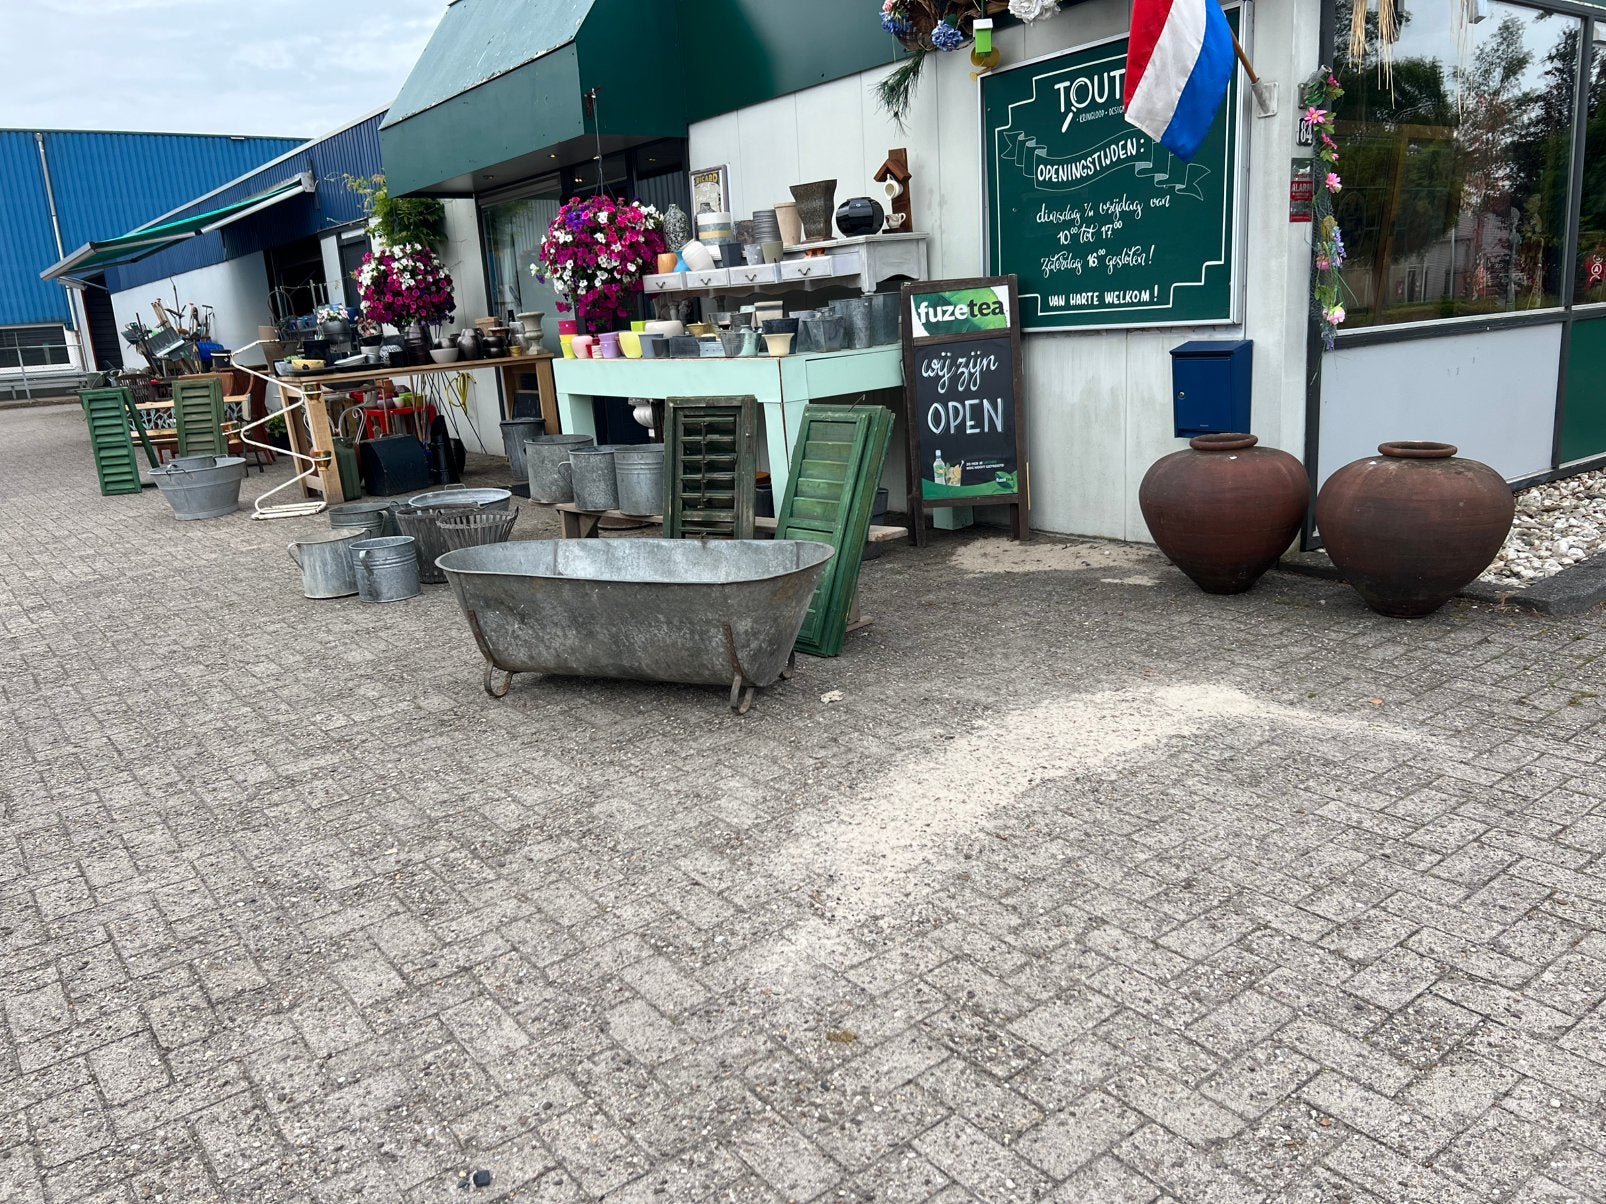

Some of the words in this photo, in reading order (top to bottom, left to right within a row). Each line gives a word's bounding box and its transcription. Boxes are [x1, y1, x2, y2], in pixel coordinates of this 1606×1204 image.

[1108, 105, 1125, 116] DESIG
[1037, 137, 1145, 182] OPENINGSTIJDEN:
[1036, 203, 1081, 226] dinsdag
[1099, 193, 1143, 221] vrijdag
[1150, 195, 1170, 208] van
[1078, 223, 1098, 243] tot
[1048, 295, 1065, 307] VAN
[1070, 292, 1099, 305] HARTE
[921, 351, 955, 394] wij
[956, 350, 998, 391] zijn
[927, 397, 1004, 435] OPEN
